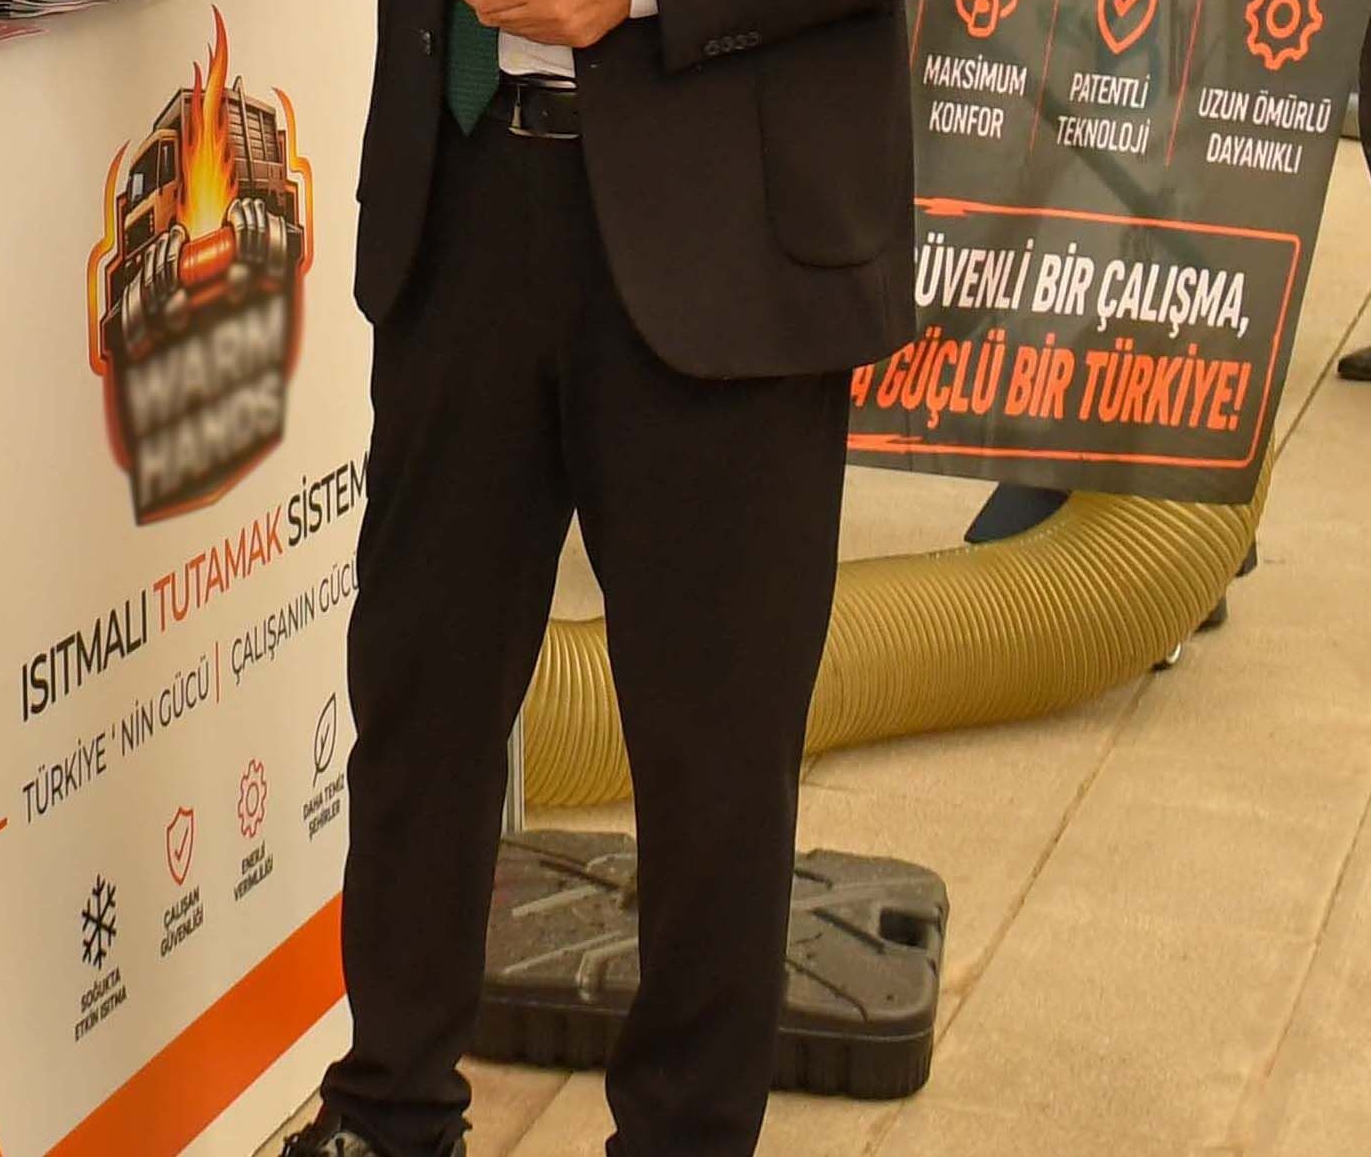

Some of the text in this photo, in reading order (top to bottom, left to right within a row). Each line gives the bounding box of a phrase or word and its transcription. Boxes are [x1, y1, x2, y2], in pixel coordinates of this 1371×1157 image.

[923, 54, 1027, 98] MAKSİMUM
[1069, 72, 1149, 110] PATENTLİ
[929, 100, 1004, 140] KONFOR
[1198, 87, 1332, 134] UZUN ÖMÜRLÜ
[1058, 115, 1149, 156] TEKNOLOJİ
[1206, 134, 1302, 174] DAYANIKLI
[914, 231, 1250, 339] ÜVENLİ BİR ÇALIŞMA,
[877, 326, 1006, 430] GÜÇLÜ
[1004, 333, 1074, 420] BİR
[1078, 338, 1252, 432] TÜRKİYE!
[22, 588, 148, 722] ISITMALI
[152, 505, 284, 633] TUTAMAK
[22, 733, 106, 824] TÜRKİYE
[158, 656, 211, 729] GÜCÜ
[230, 590, 316, 686] ÇALIŞANIN
